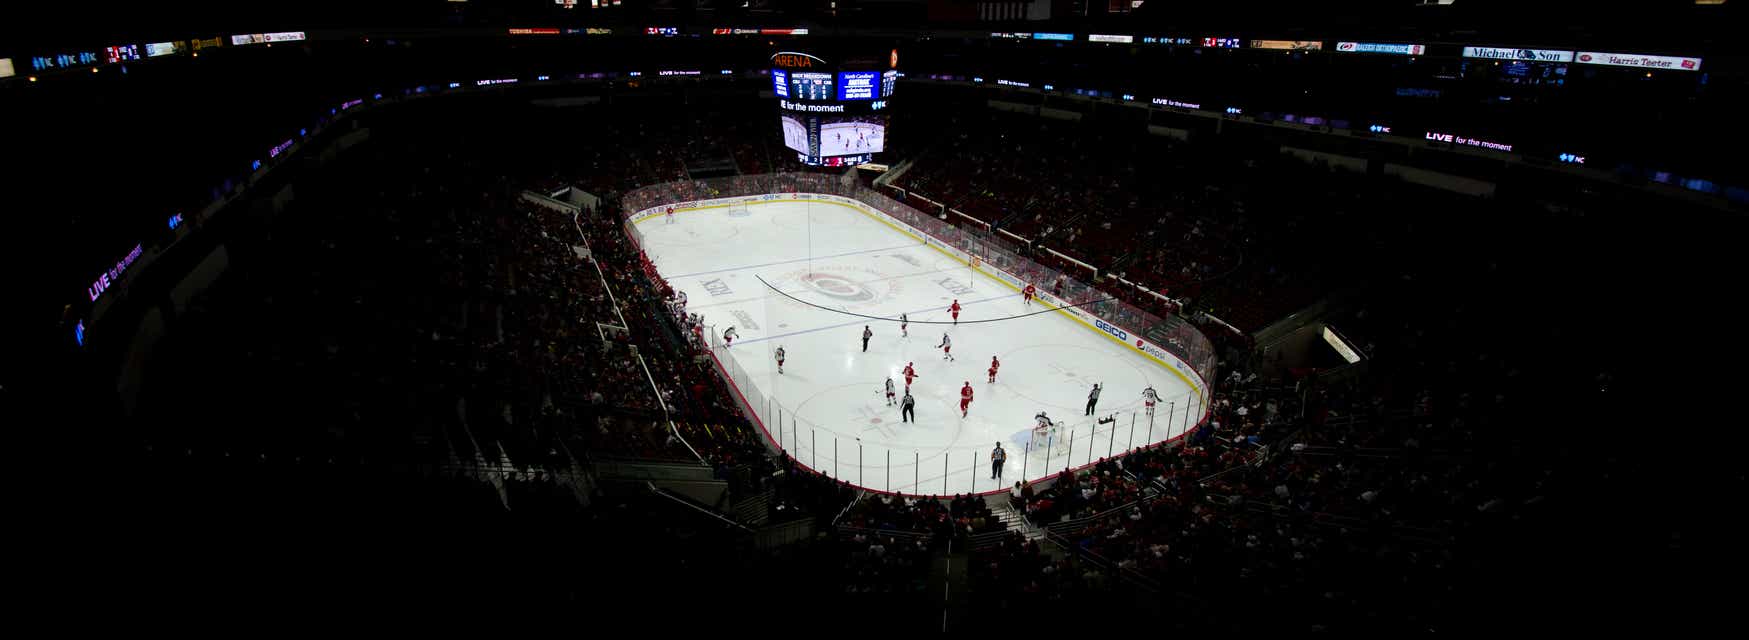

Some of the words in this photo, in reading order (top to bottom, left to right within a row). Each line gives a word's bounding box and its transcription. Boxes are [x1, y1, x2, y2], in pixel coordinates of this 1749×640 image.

[1472, 47, 1514, 58] Michael
[1538, 51, 1561, 61] Son
[775, 55, 812, 68] ARENA
[1608, 56, 1639, 65] Harris
[1641, 57, 1672, 67] Teeter
[787, 101, 795, 110] for
[795, 102, 806, 111] the
[1426, 132, 1453, 142] LIVE
[1456, 136, 1467, 144] for
[1468, 138, 1480, 146] the
[1481, 141, 1512, 151] moment
[88, 272, 110, 302] LIVE
[1095, 319, 1127, 341] GEICO
[1145, 346, 1166, 360] pepsi
